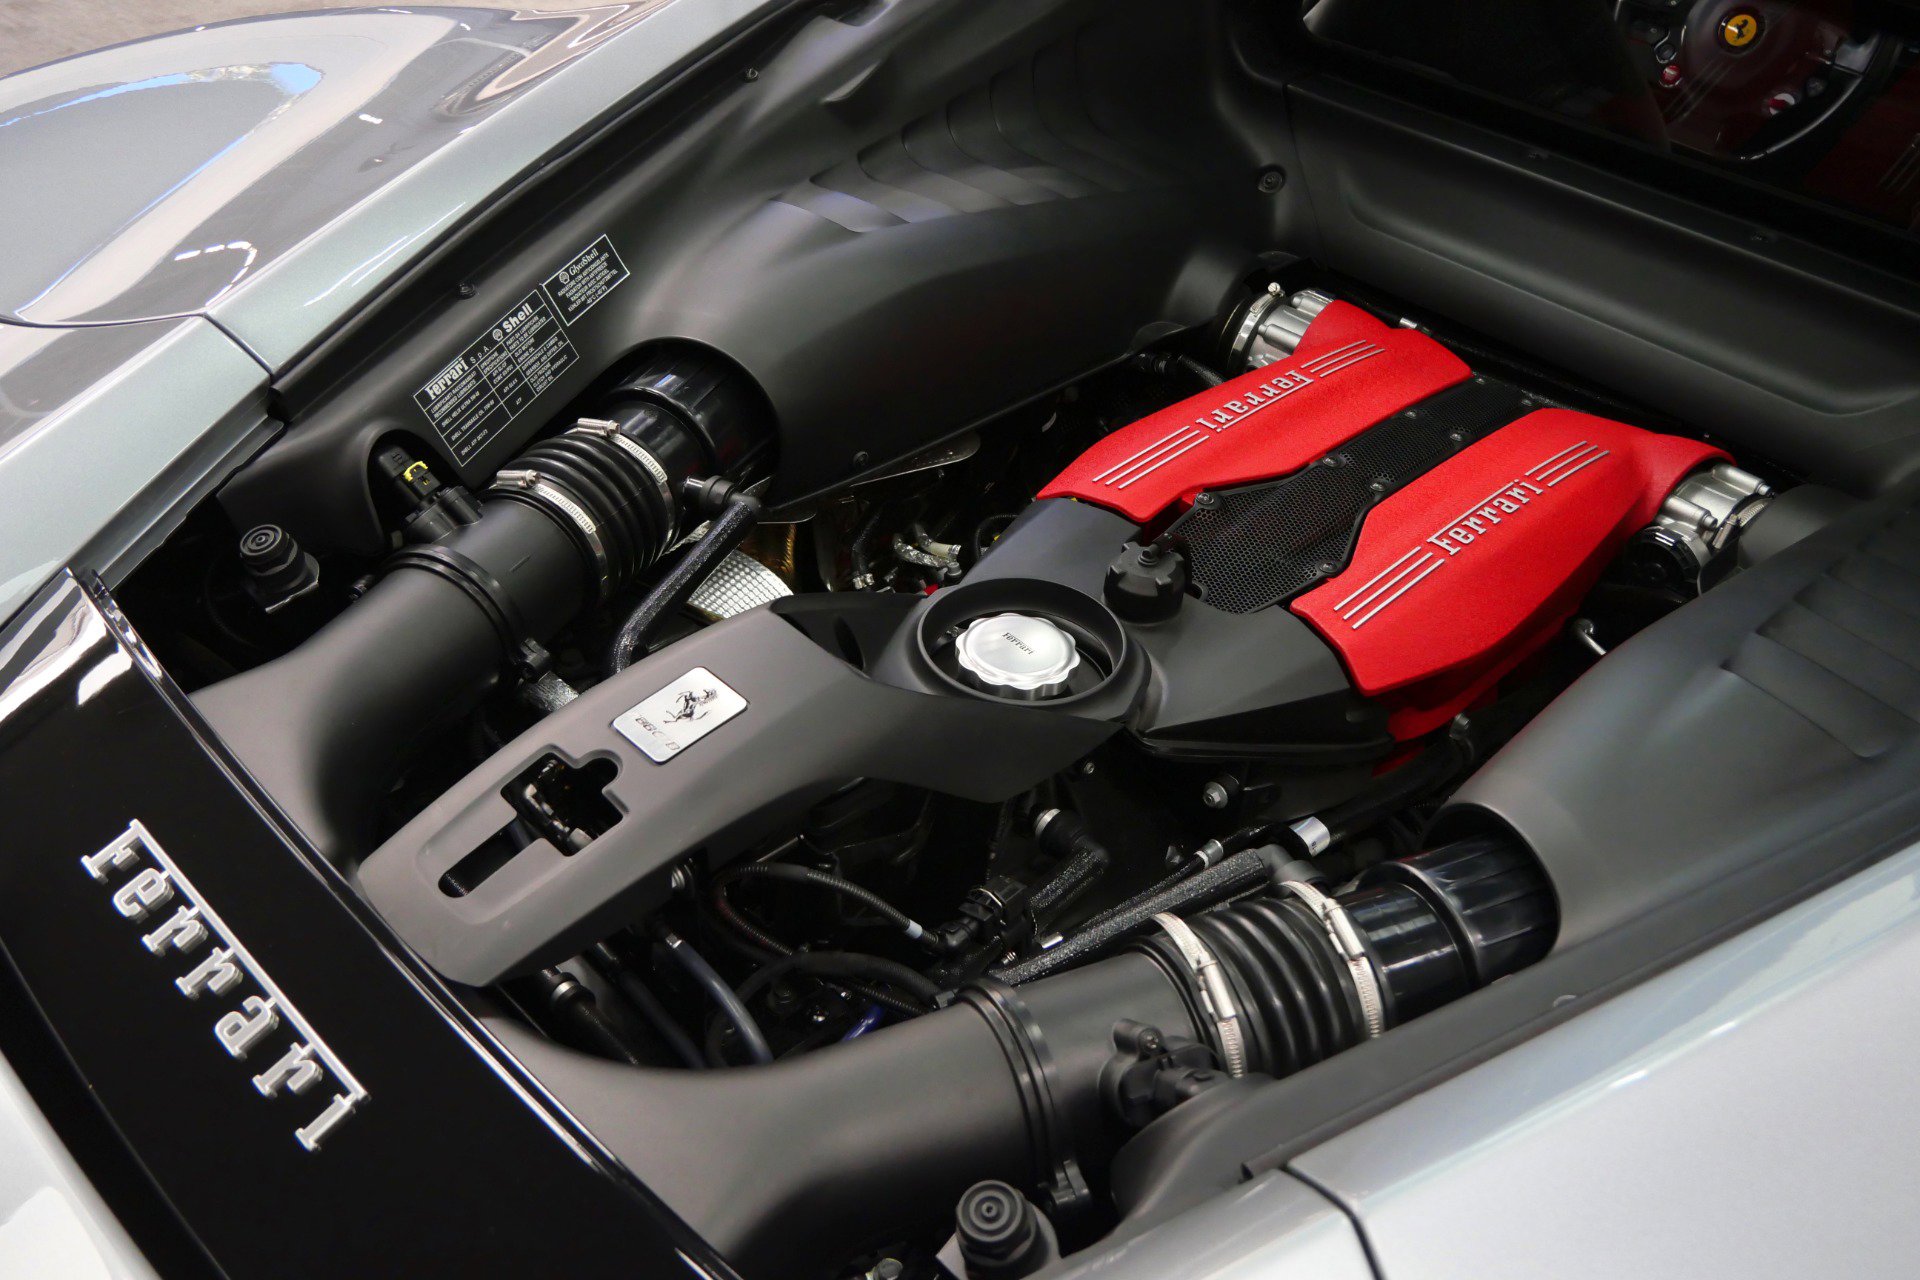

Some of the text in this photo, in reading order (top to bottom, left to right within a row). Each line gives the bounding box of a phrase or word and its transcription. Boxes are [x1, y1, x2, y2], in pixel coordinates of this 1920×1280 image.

[424, 357, 469, 400] Ferrari
[502, 302, 532, 333] Shell
[1195, 370, 1314, 432] Ferrari
[1426, 479, 1543, 556] Ferrari
[1002, 632, 1034, 655] Ferrari
[81, 818, 369, 1151] Ferrari
